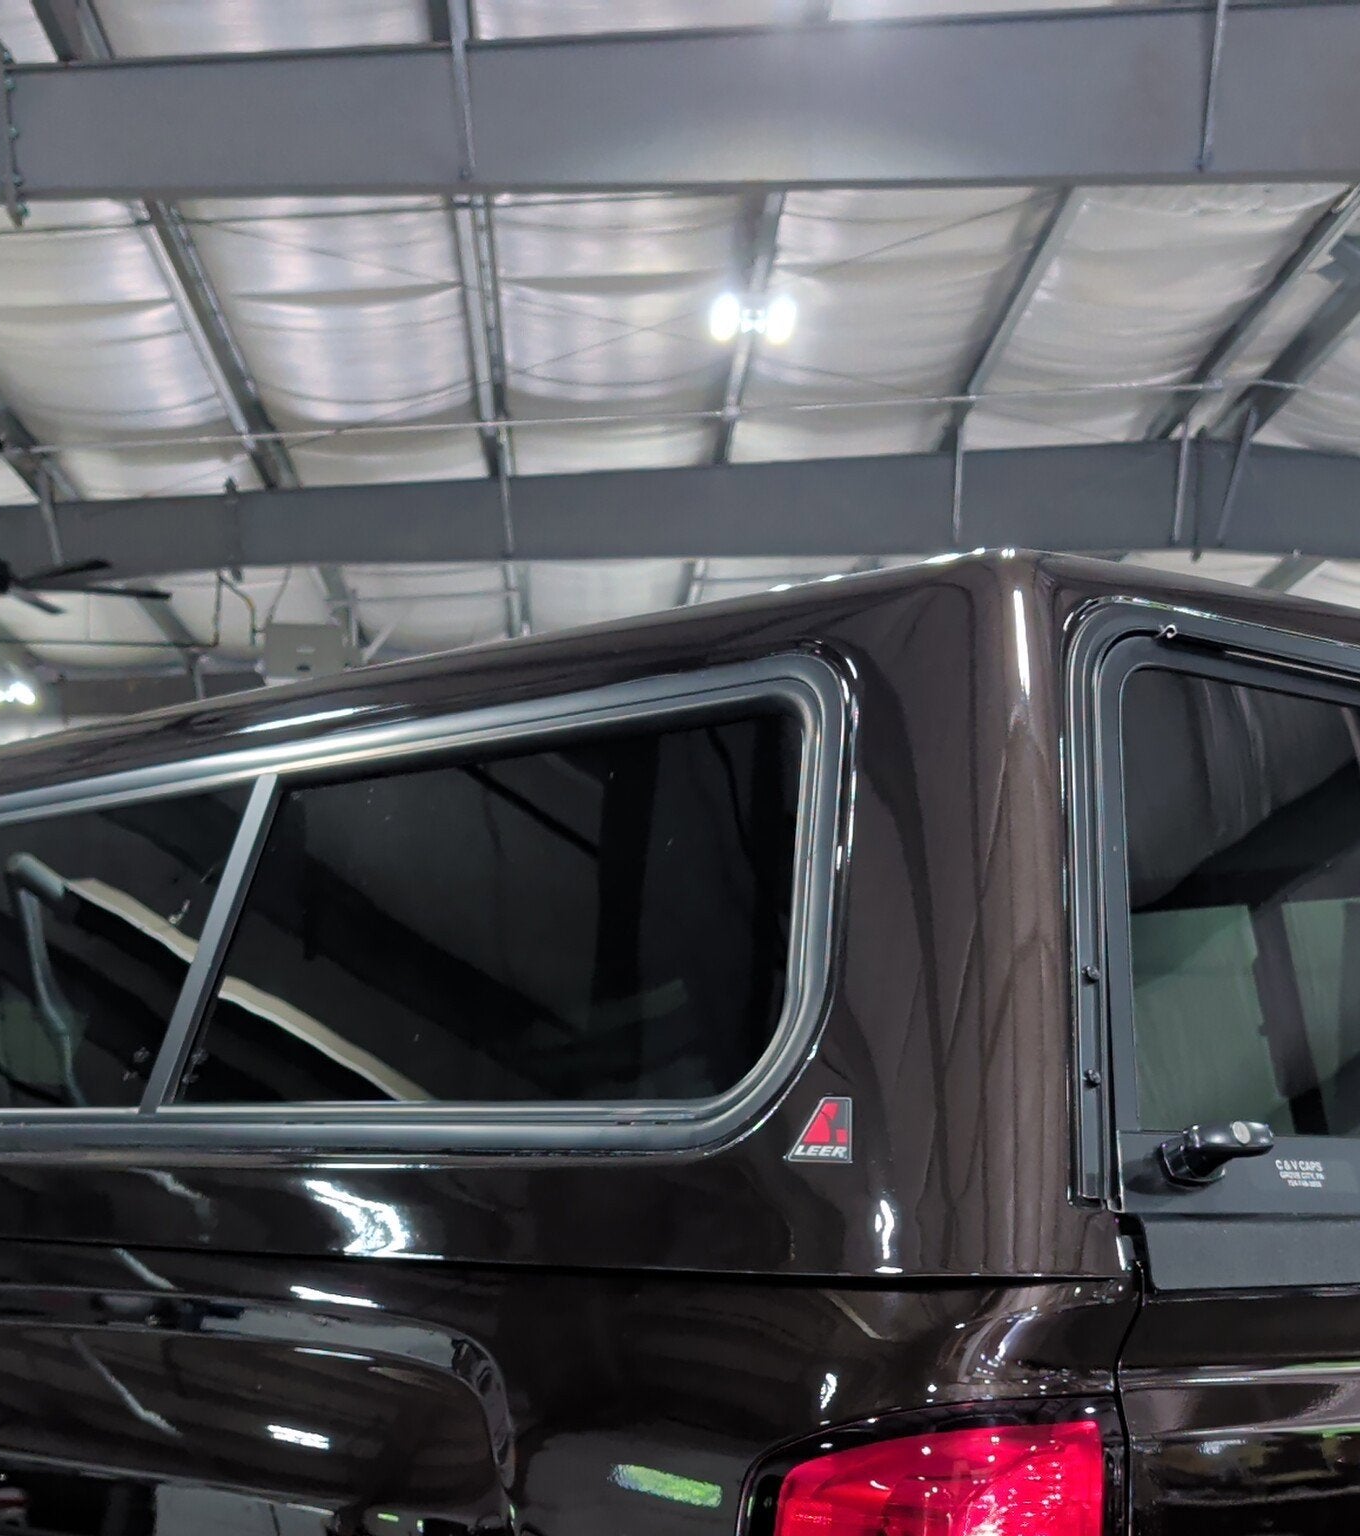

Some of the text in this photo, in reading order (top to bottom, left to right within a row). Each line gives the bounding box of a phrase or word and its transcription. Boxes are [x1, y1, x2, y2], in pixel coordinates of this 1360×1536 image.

[794, 1144, 847, 1158] LEER
[1275, 1159, 1284, 1171] C
[1299, 1160, 1323, 1172] CAPS
